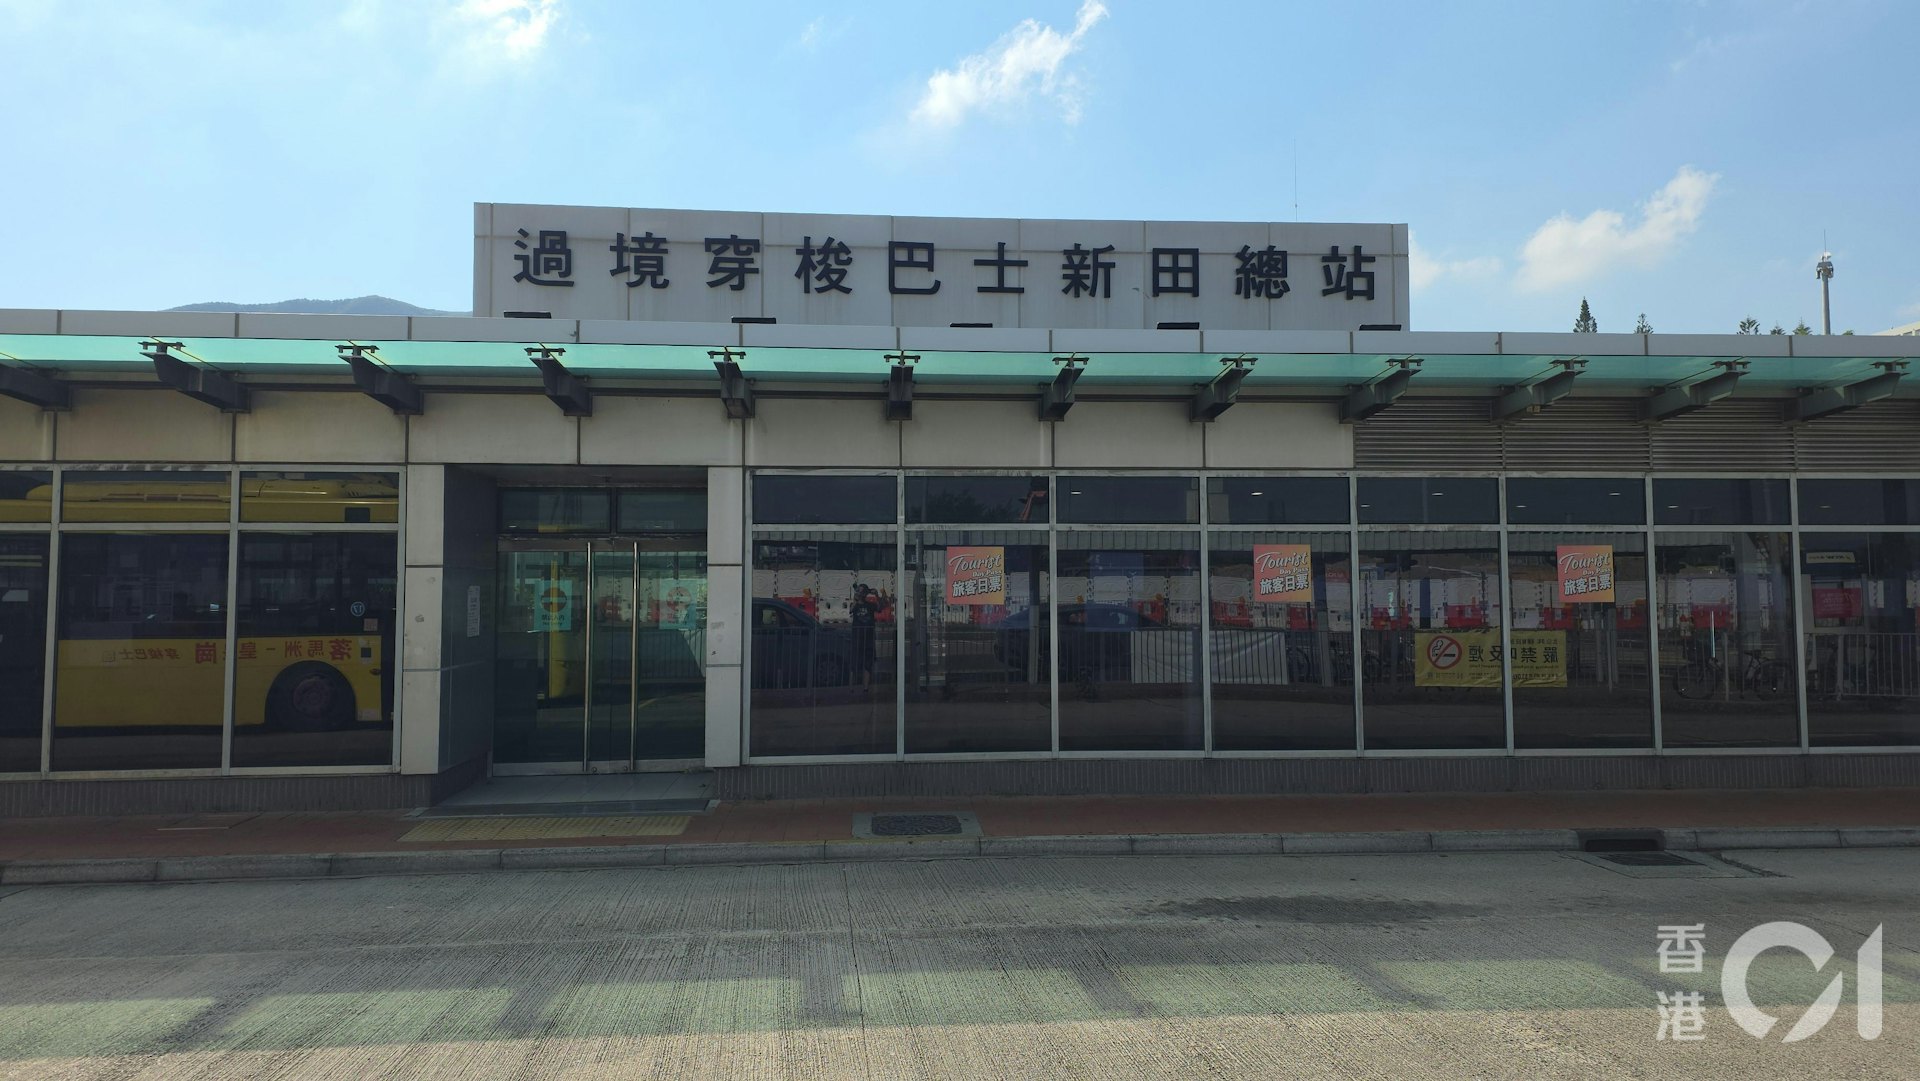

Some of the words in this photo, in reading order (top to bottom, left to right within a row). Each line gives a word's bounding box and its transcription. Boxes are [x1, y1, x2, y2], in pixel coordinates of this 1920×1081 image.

[513, 228, 1376, 301] 過境穿梭巴士新田總站
[949, 553, 1001, 575] Tourist
[1255, 551, 1308, 573] Tourist
[1559, 552, 1610, 574] Tourist
[952, 576, 1001, 597] 旅客日票
[1260, 573, 1309, 595] 旅客日票
[1564, 574, 1611, 595] 旅客日票
